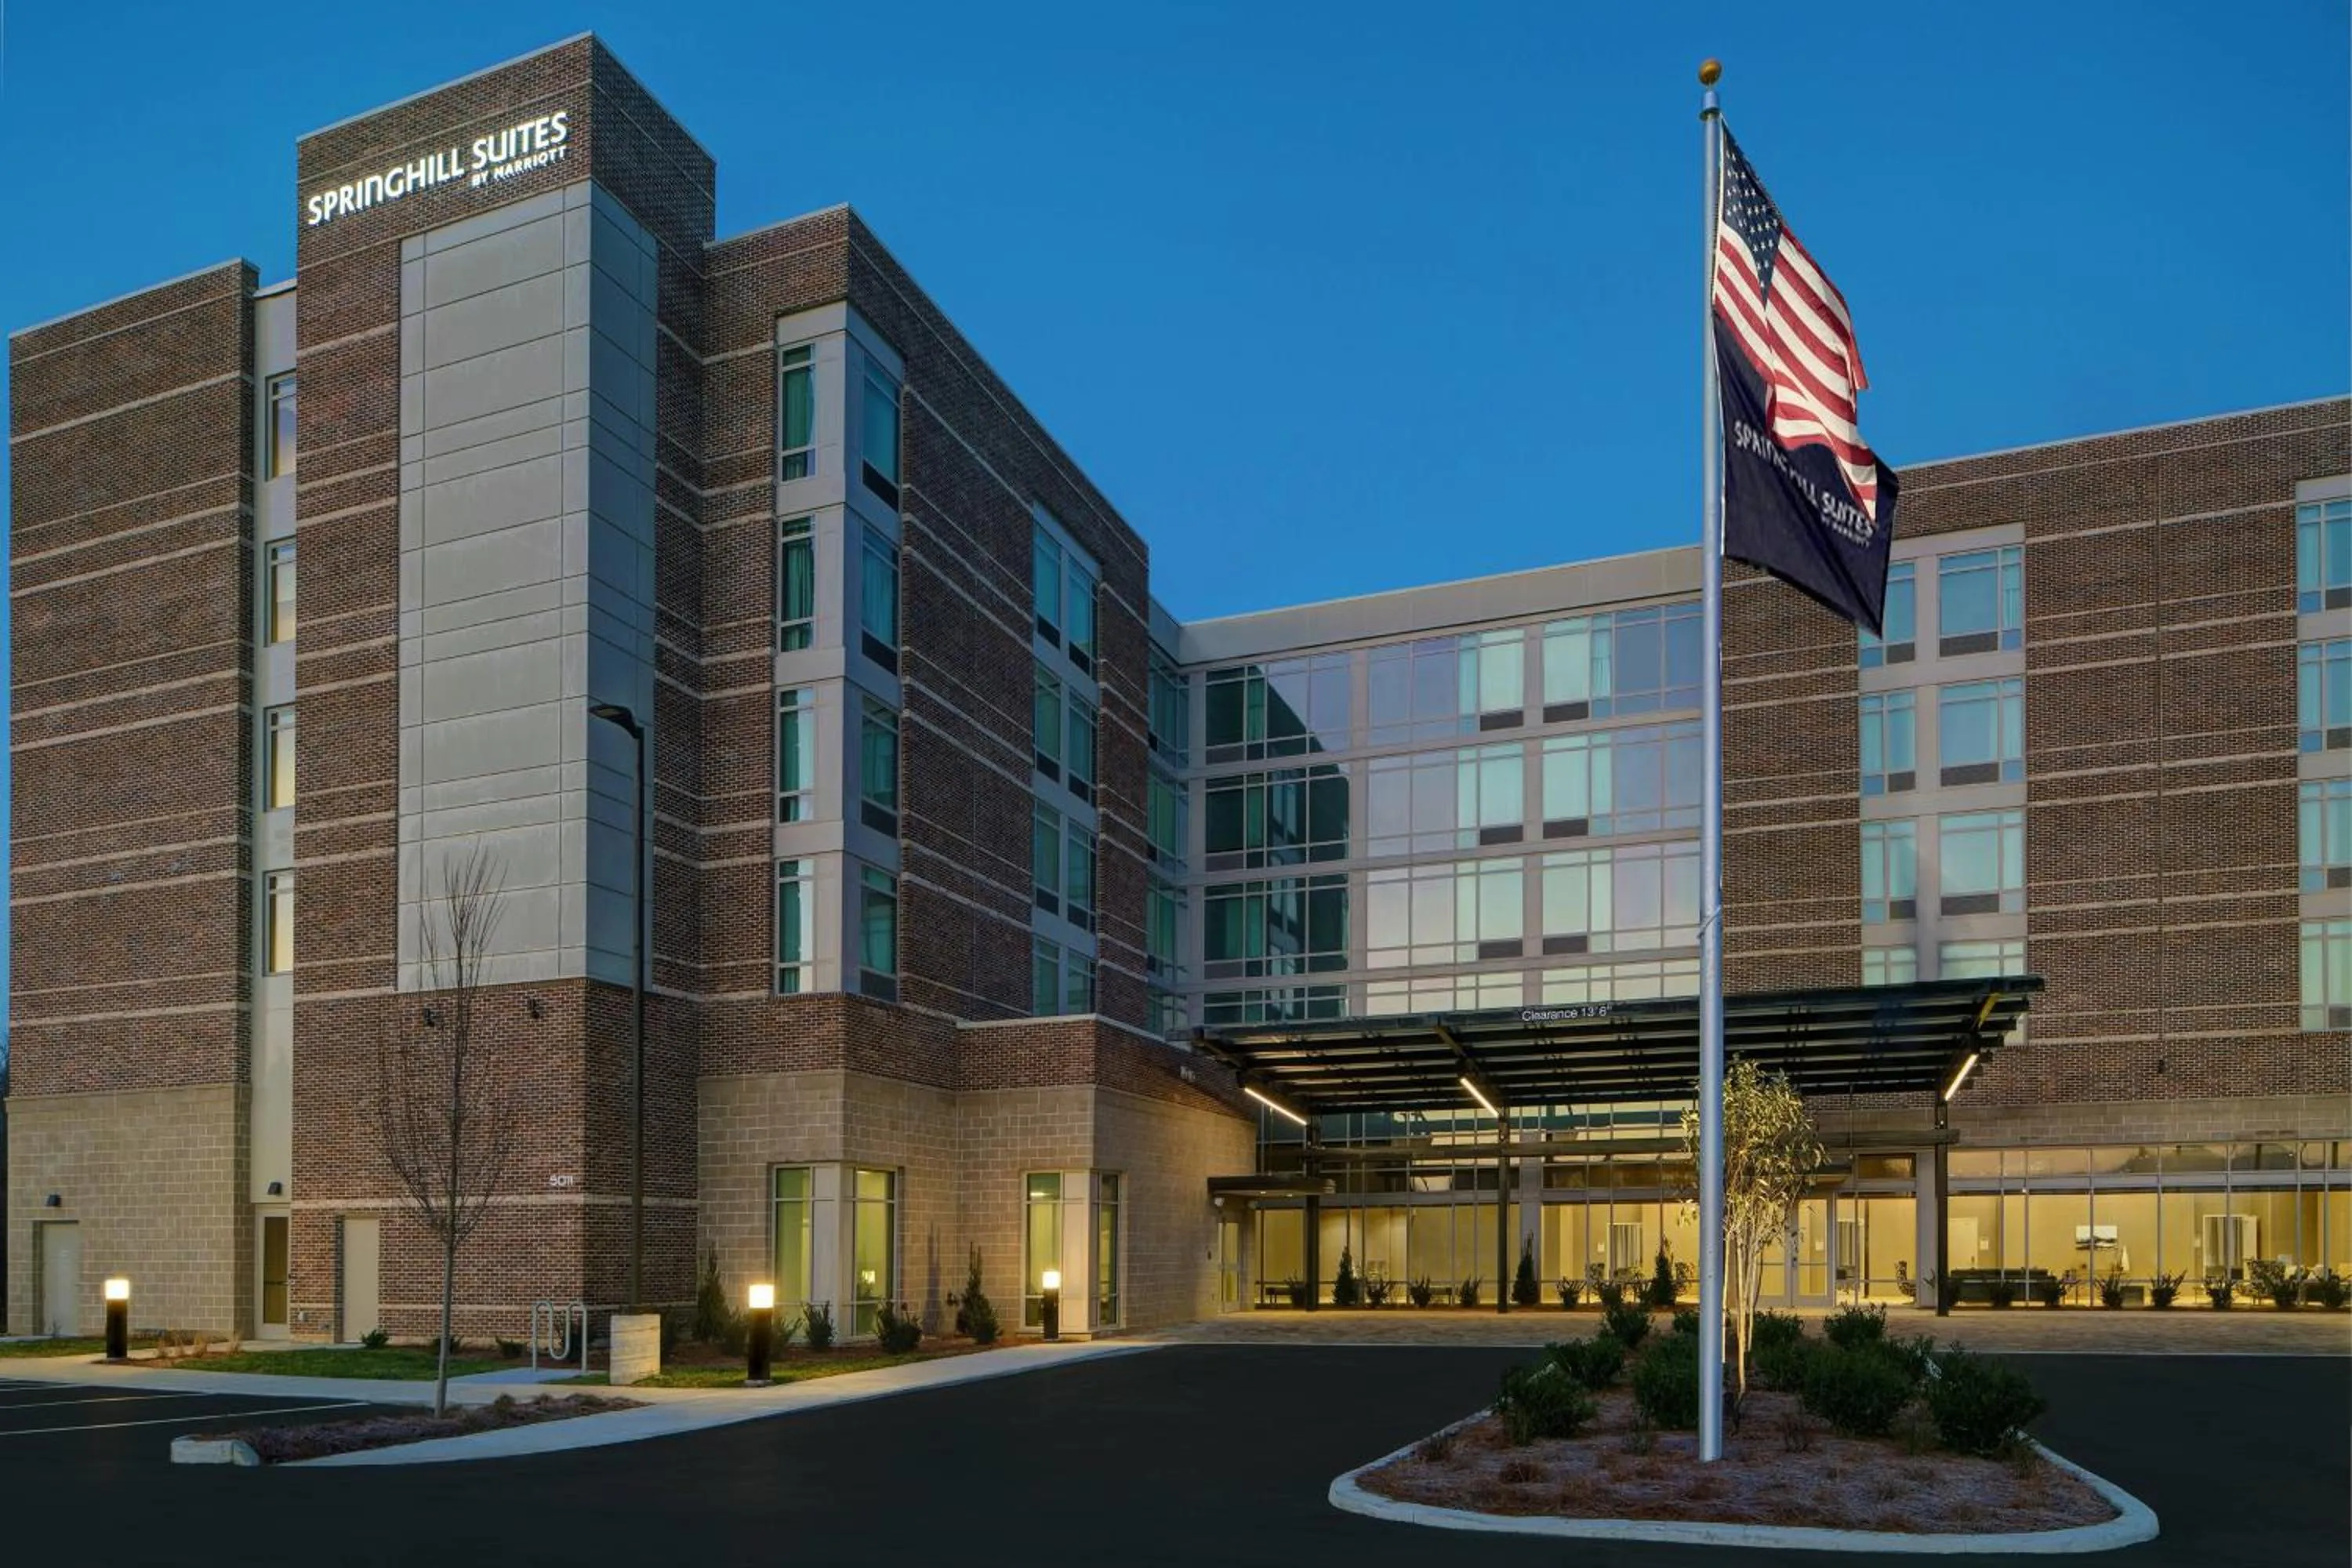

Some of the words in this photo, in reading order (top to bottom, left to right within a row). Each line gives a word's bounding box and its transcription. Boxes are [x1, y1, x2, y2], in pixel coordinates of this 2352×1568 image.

[307, 148, 465, 226] SPRINGHILL
[472, 111, 568, 169] SUITES
[472, 170, 488, 188] BY
[494, 145, 567, 180] MARRIOTT
[1522, 1008, 1578, 1022] Clearance
